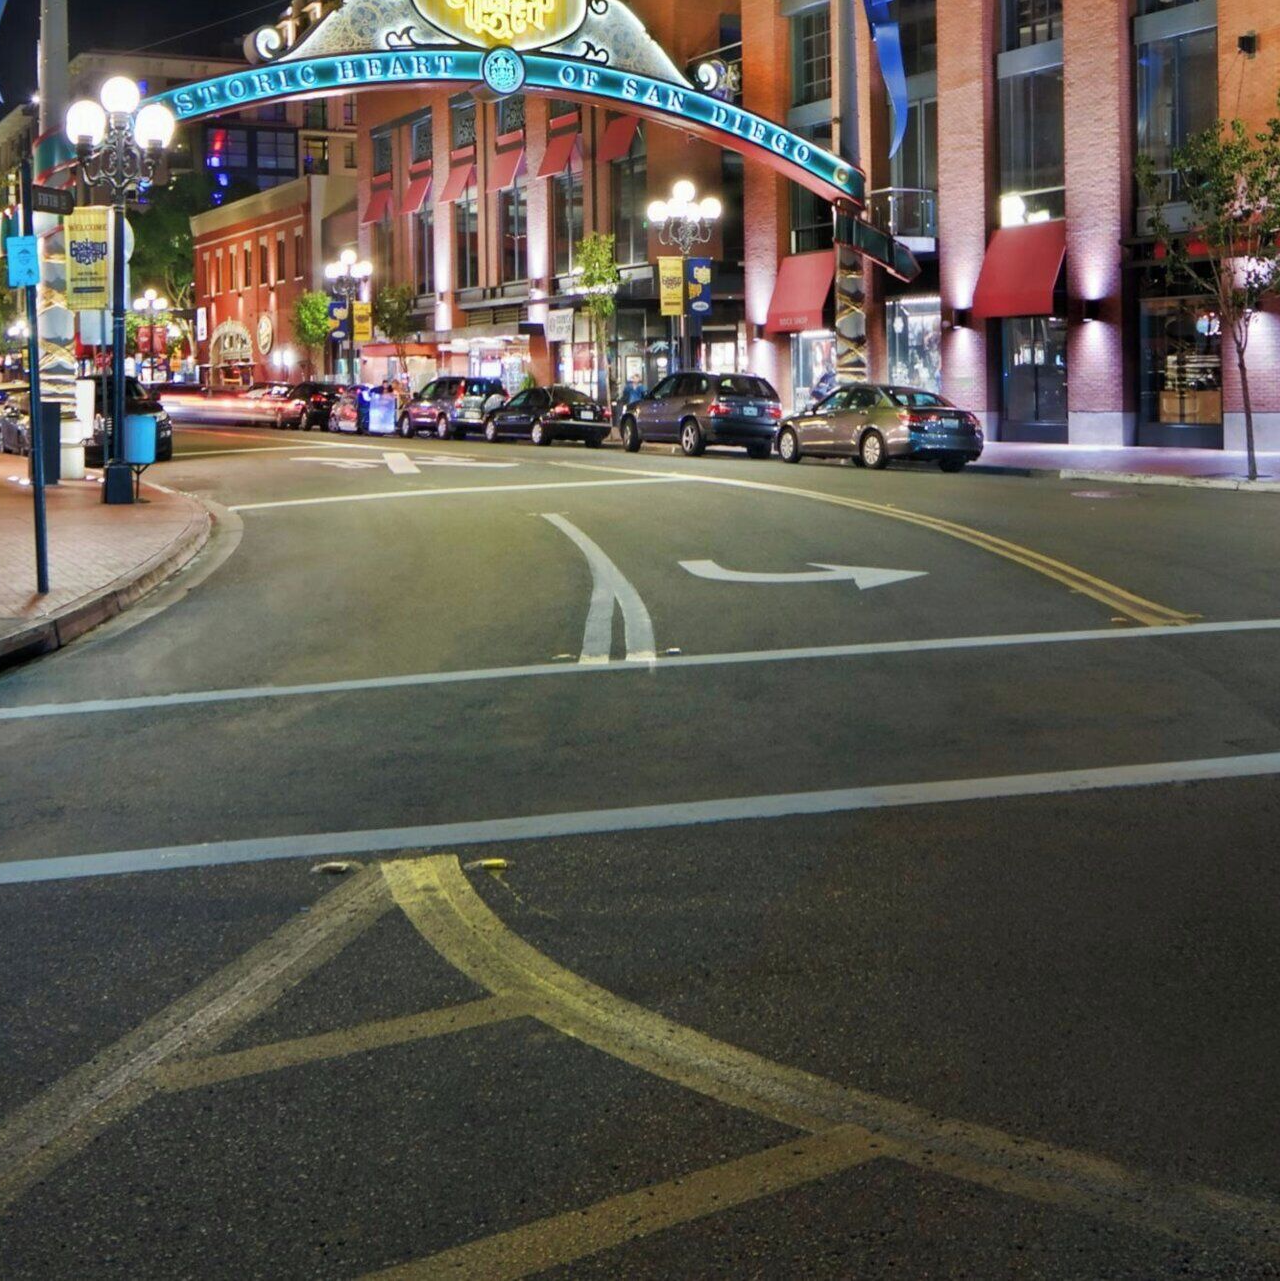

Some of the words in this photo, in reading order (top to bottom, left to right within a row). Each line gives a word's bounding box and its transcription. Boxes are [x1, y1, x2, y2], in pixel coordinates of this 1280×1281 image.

[173, 63, 317, 114] STORIC
[334, 54, 456, 81] HEART
[559, 65, 599, 88] OF
[622, 78, 687, 113] SAN
[711, 104, 813, 164] DIEGO
